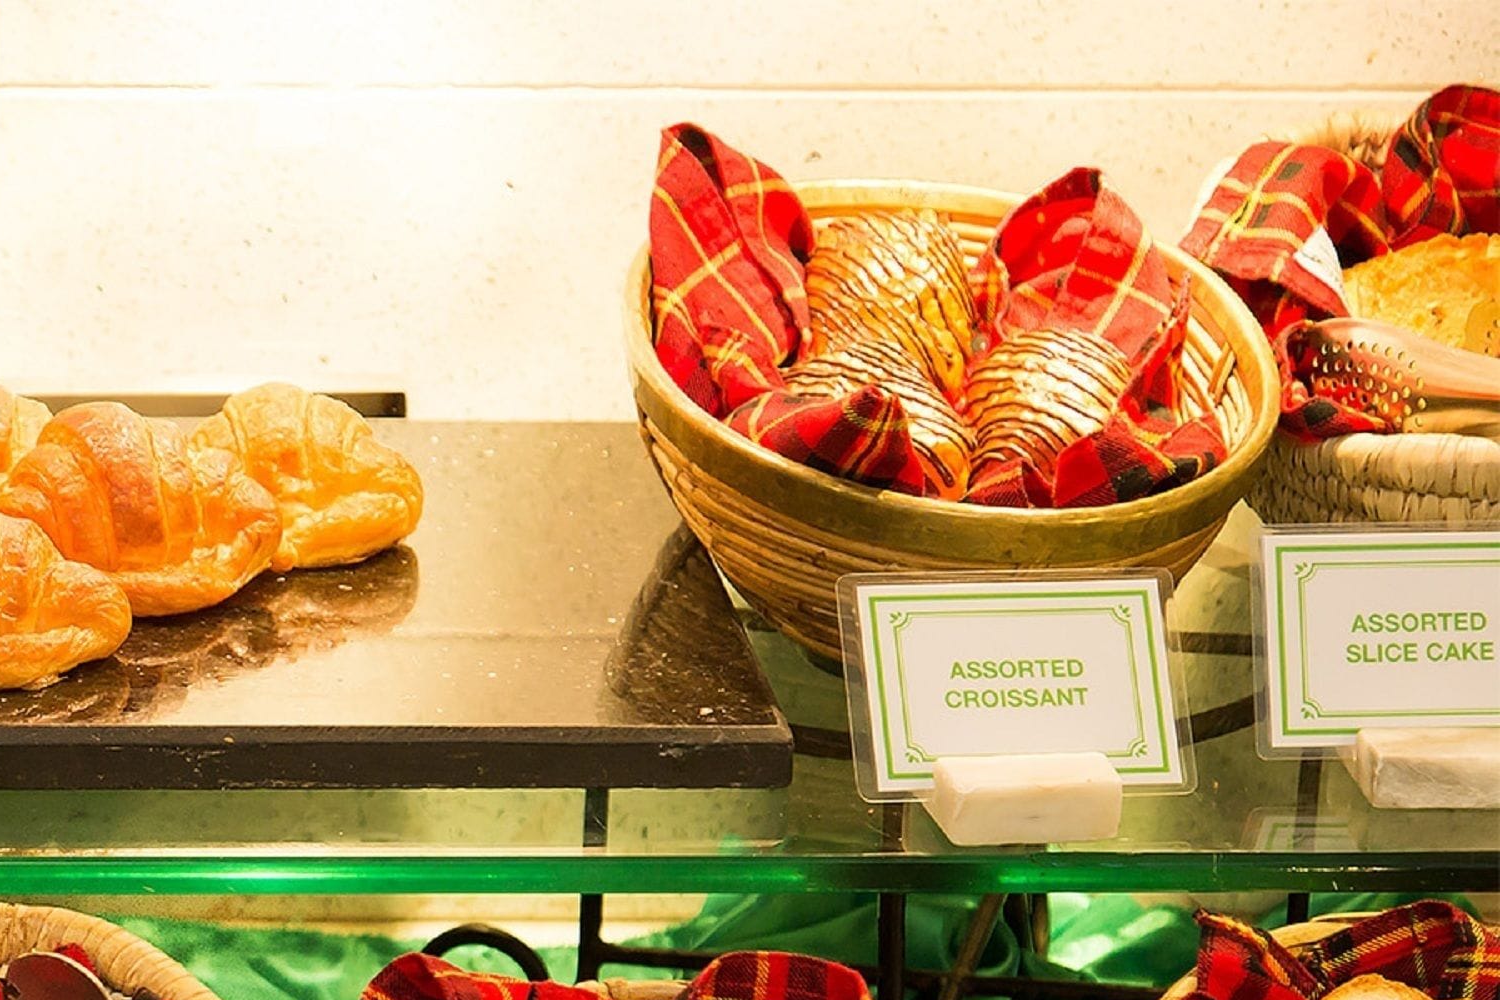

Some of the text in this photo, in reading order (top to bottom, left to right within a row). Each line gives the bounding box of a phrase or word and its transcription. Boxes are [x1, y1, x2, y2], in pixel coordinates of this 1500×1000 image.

[1351, 611, 1488, 634] ASSORTED
[1346, 641, 1495, 664] SLICE CAKE
[949, 658, 1085, 680] ASSORTED
[944, 687, 1089, 710] CROISSANT
